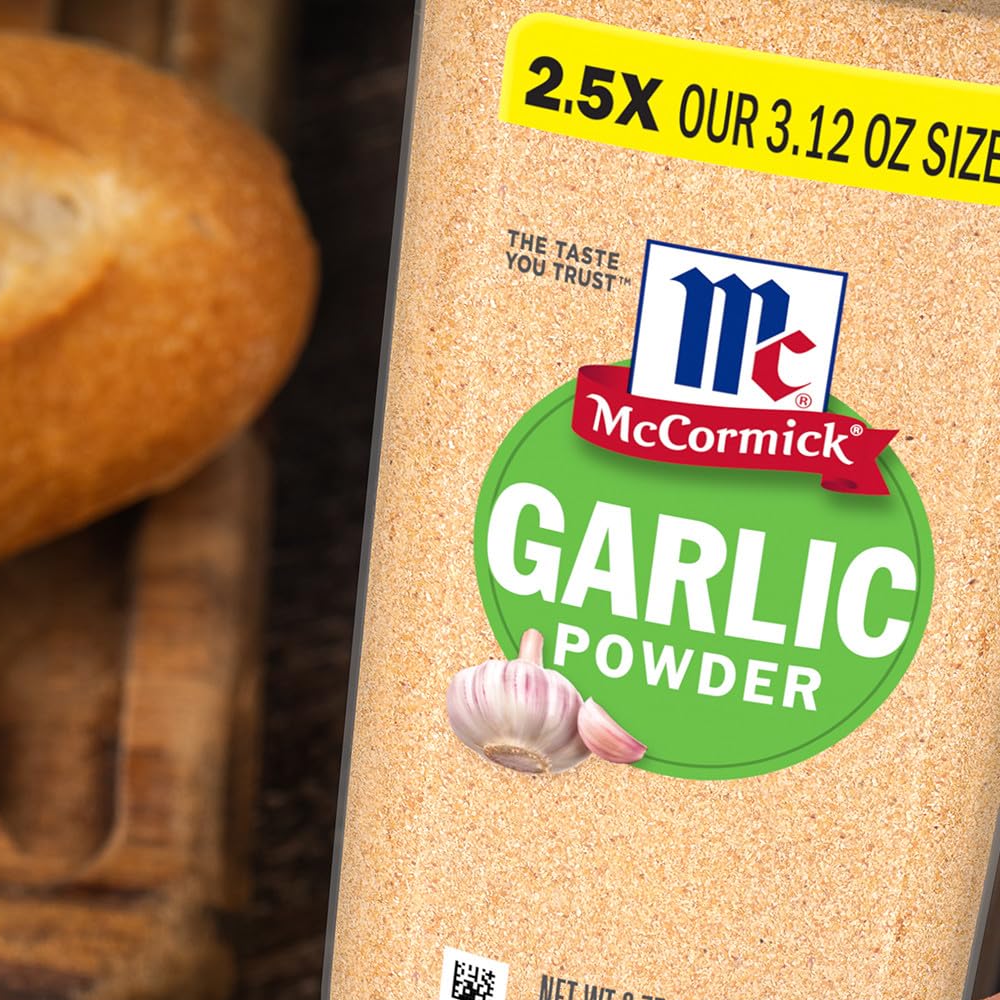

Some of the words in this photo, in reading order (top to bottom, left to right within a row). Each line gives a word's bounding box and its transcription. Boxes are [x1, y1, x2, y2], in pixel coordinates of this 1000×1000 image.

[525, 56, 663, 132] 2.5X
[678, 83, 760, 148] OUR
[765, 99, 855, 163] 3.12
[863, 112, 917, 171] OZ
[921, 121, 1000, 184] SIZE
[505, 251, 546, 277] YOU
[507, 229, 547, 255] THE
[555, 240, 620, 270] TASTE
[487, 482, 918, 659] GARLIC
[552, 622, 823, 711] POWDER
